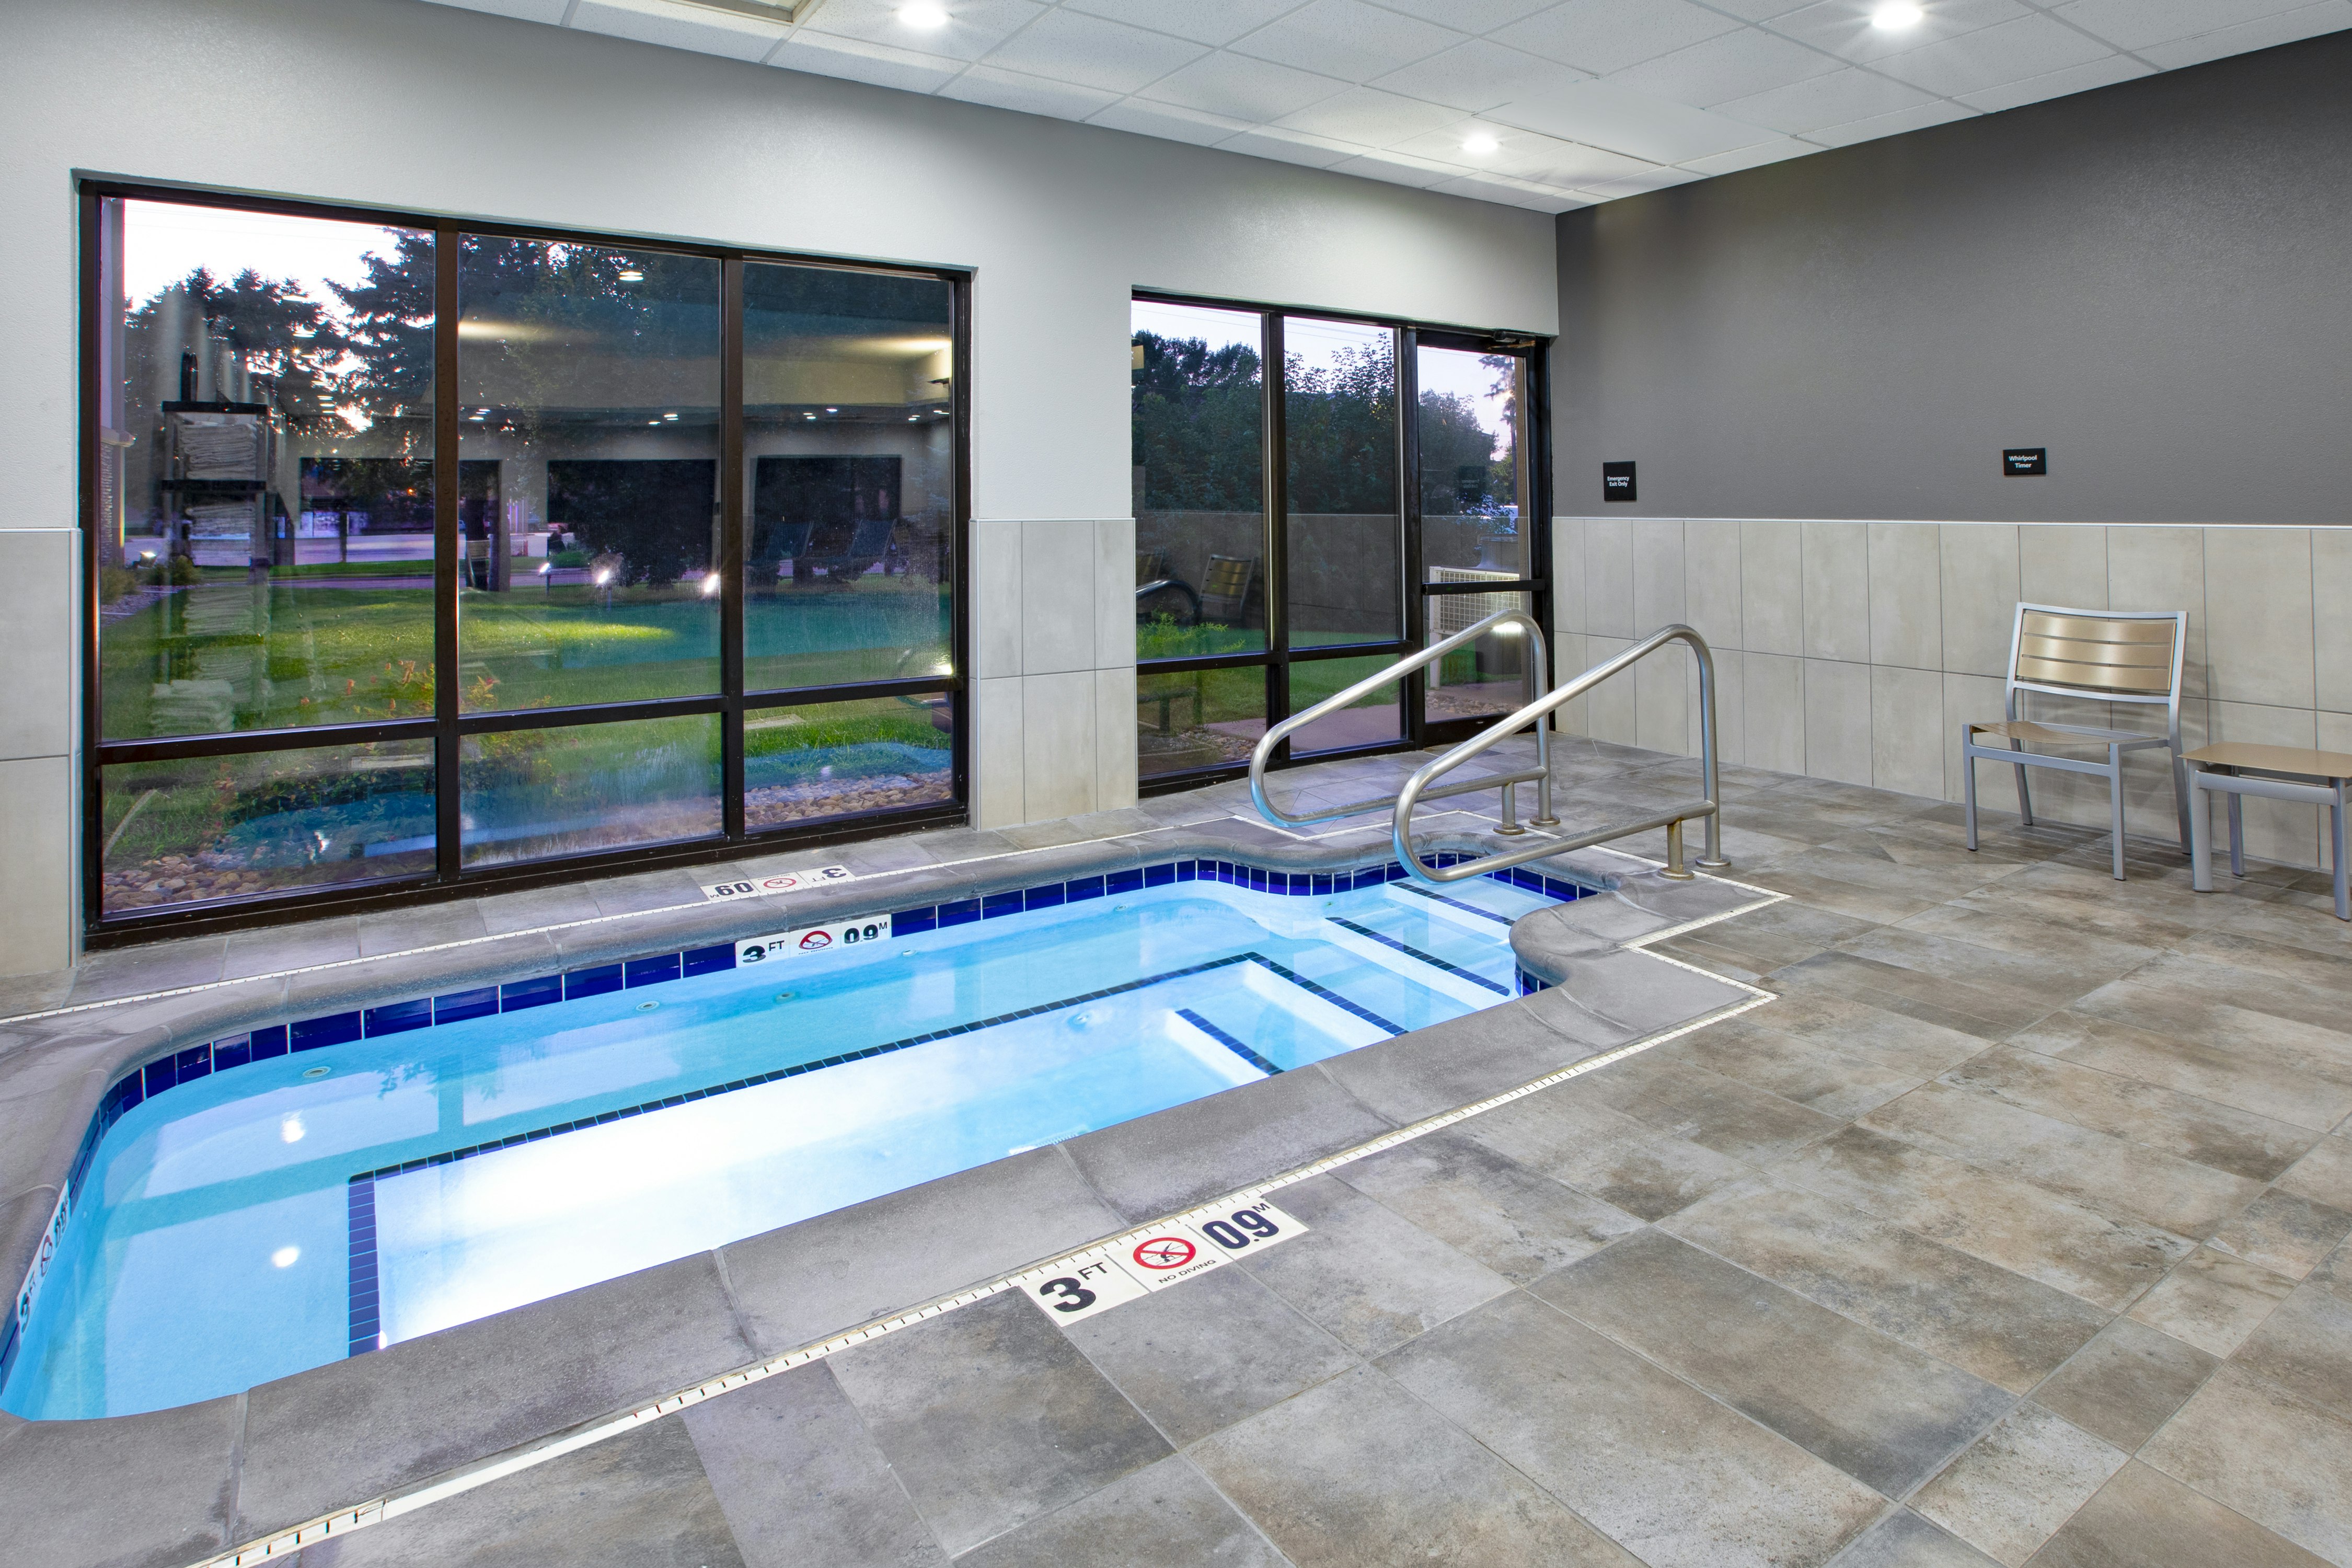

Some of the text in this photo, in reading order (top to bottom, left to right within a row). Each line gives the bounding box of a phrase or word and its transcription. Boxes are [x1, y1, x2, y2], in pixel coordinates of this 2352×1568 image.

[822, 868, 847, 878] 3
[743, 940, 785, 963] 3 FT
[1158, 1259, 1217, 1284] NO DIVING
[1039, 1262, 1109, 1313] 3 FT
